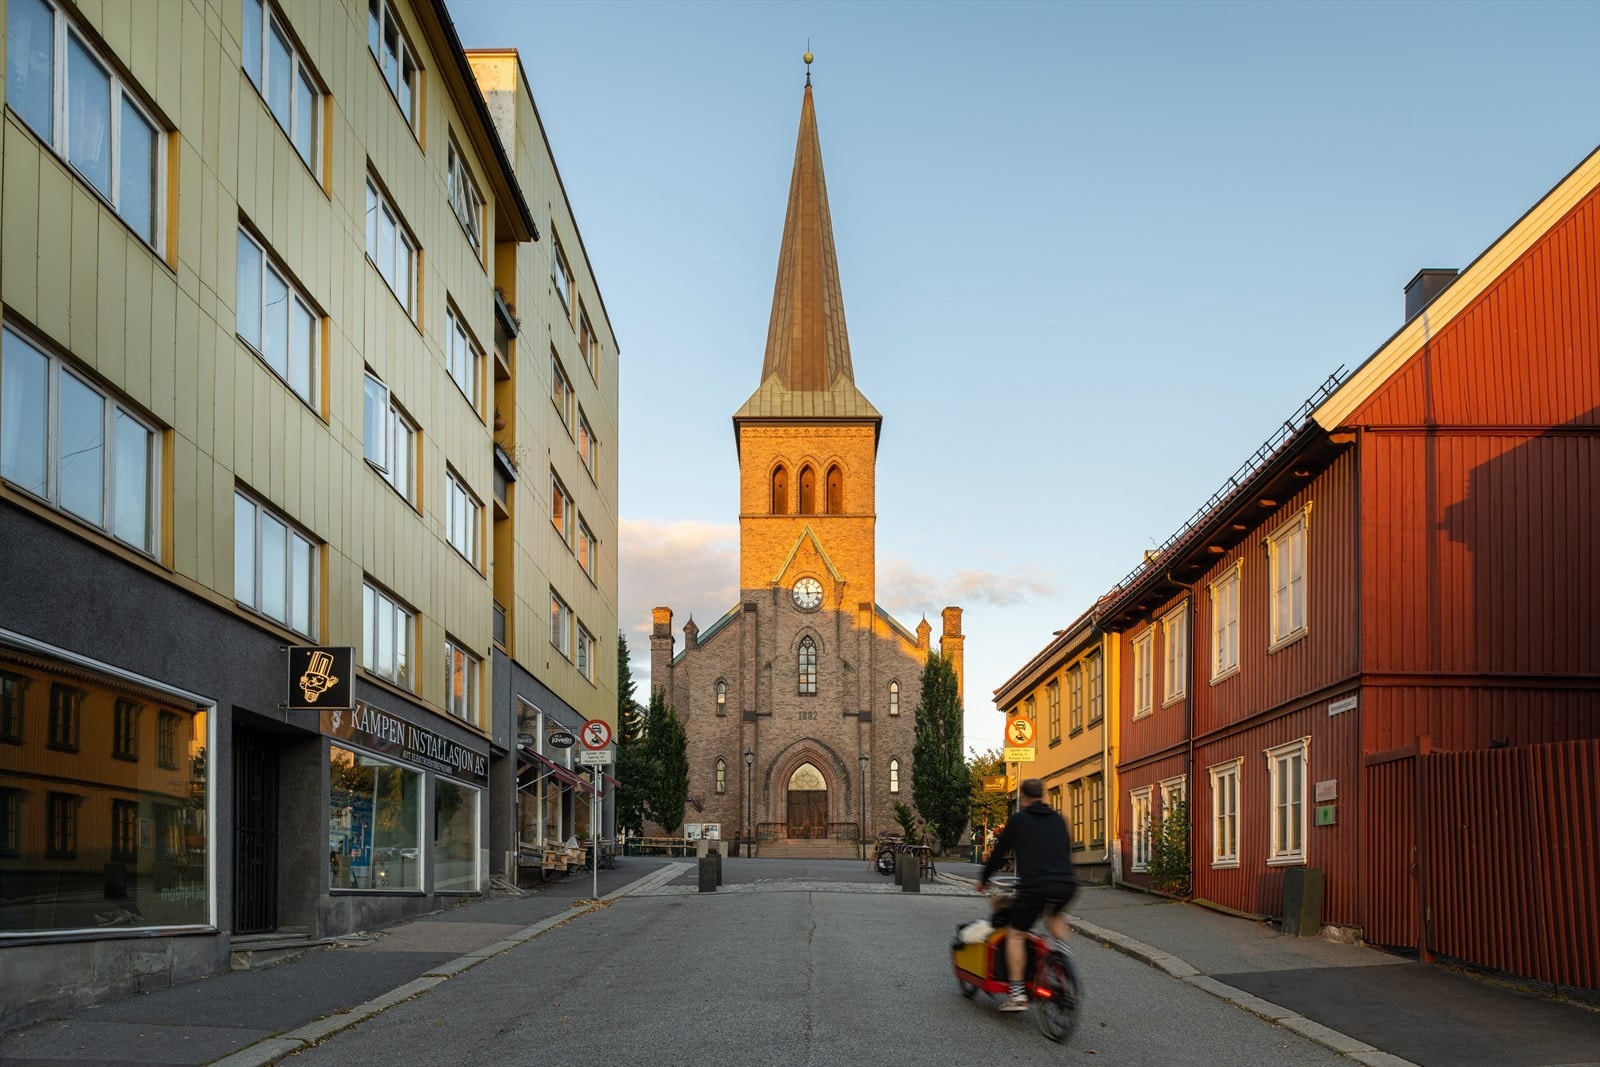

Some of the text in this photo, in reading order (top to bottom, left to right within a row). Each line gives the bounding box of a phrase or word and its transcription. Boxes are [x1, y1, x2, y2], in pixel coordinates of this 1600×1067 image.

[799, 710, 818, 720] 1882
[351, 704, 485, 776] KAMPEN INSTALLASJON AS
